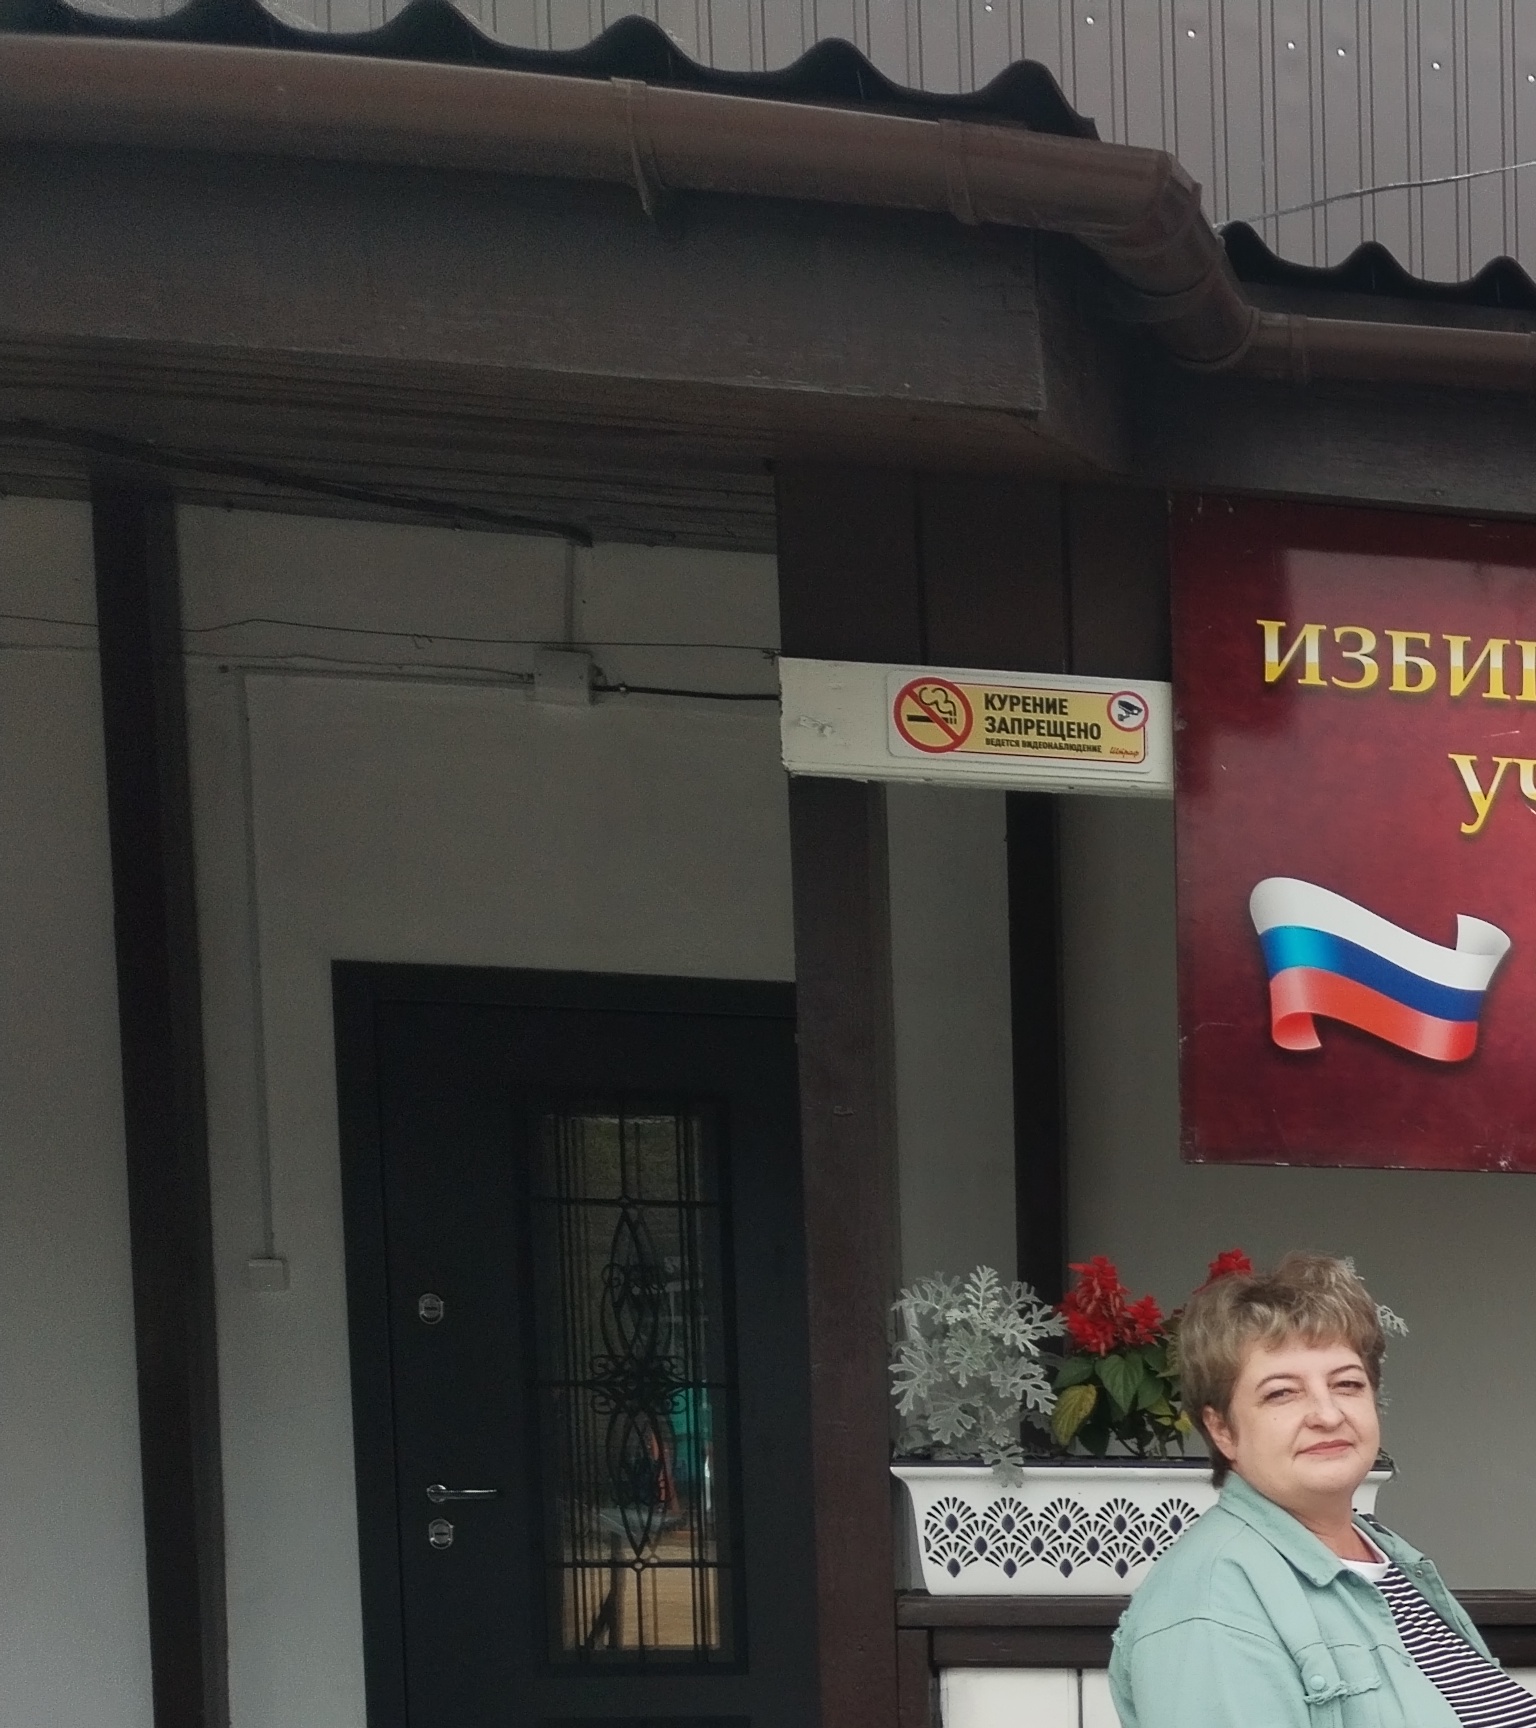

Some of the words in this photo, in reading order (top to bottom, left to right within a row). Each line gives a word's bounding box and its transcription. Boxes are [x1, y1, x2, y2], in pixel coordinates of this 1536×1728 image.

[984, 692, 1069, 716] КУРЕНИЕ
[984, 716, 1102, 742] ЗАПРЕЩЕНО
[985, 737, 1021, 749] ВЕДЕТСЯ
[1021, 741, 1103, 754] ВИДЕОНАБЛЮДЕНИЕ
